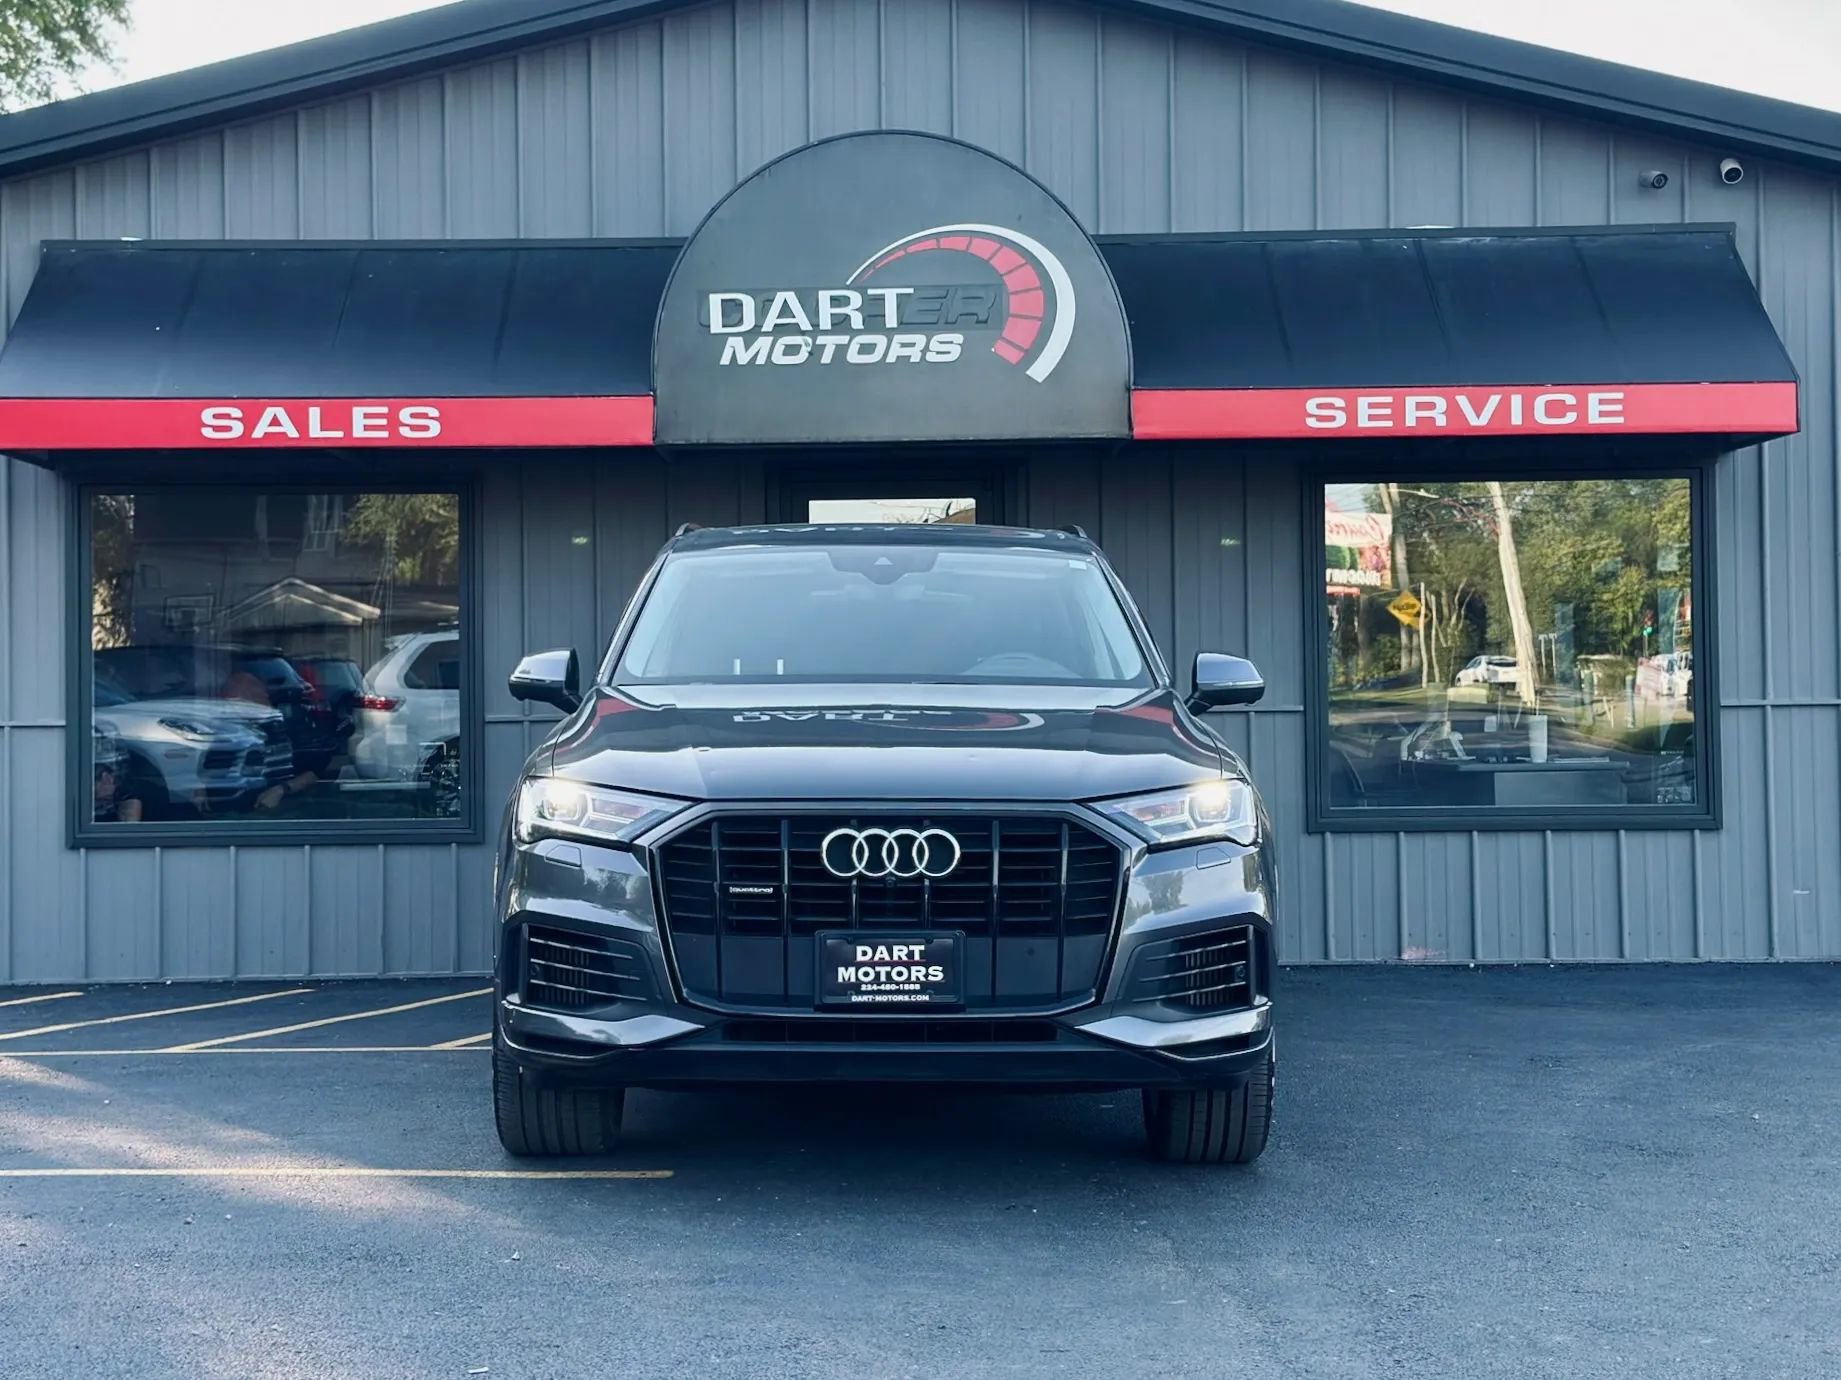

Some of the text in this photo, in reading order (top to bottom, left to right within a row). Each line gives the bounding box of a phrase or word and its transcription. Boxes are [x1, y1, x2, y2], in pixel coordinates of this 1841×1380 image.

[708, 287, 915, 334] DART
[719, 333, 965, 365] MOTORS
[200, 406, 442, 439] SALES
[1304, 391, 1625, 428] SERVICE
[855, 944, 926, 962] DART
[837, 965, 945, 982] MOTORS
